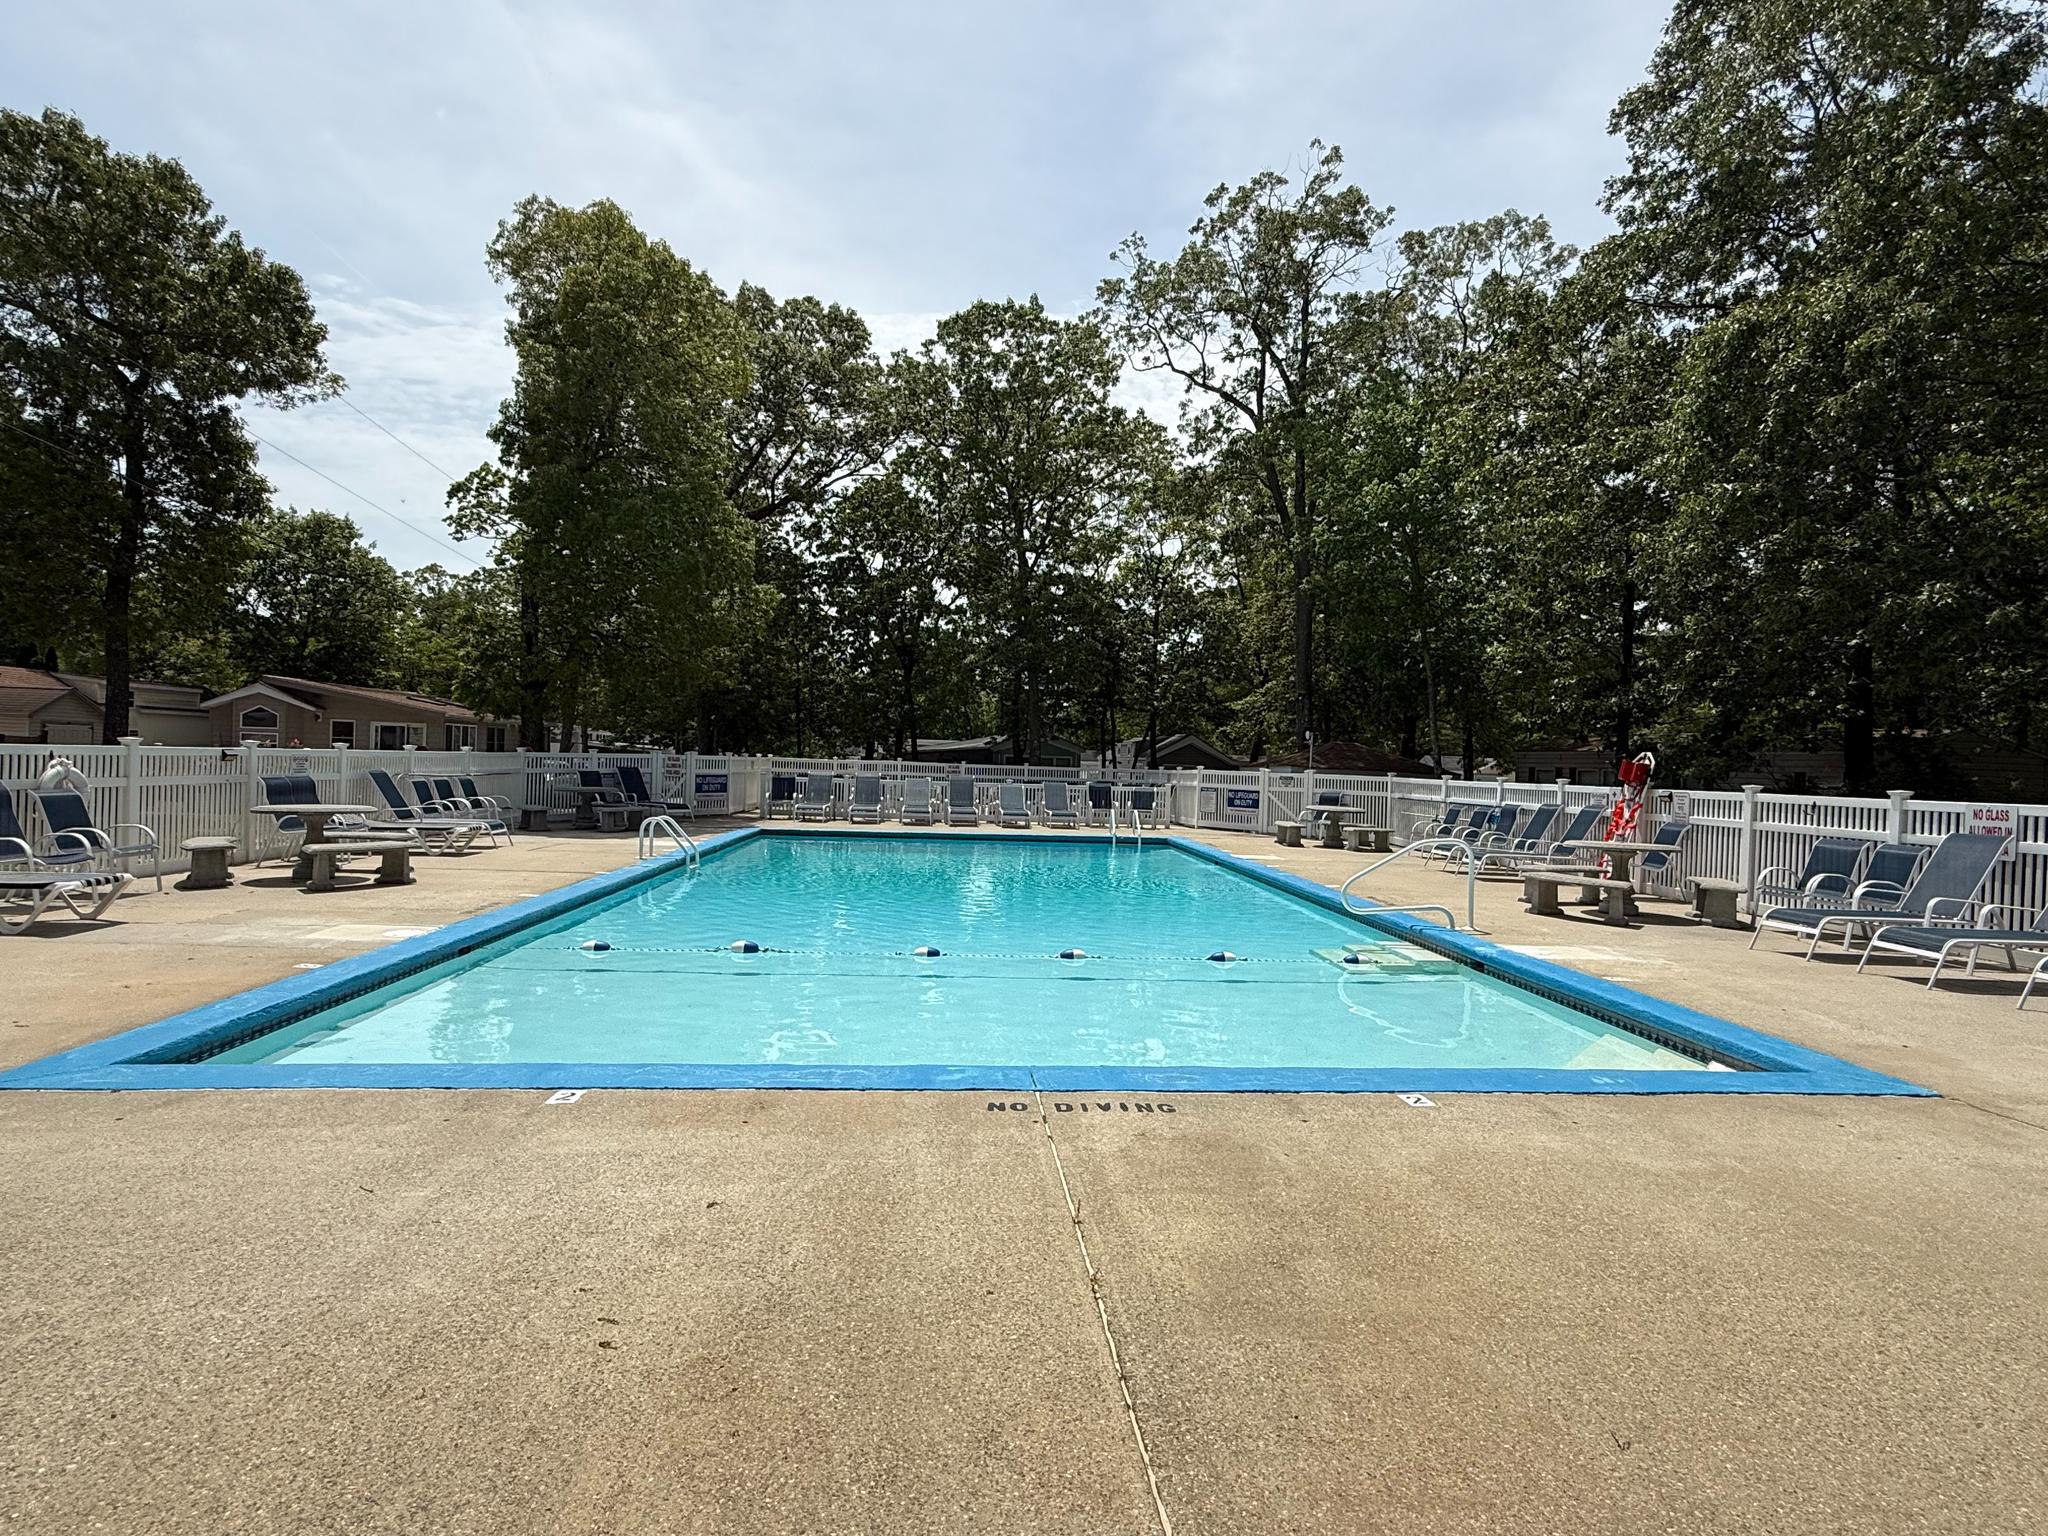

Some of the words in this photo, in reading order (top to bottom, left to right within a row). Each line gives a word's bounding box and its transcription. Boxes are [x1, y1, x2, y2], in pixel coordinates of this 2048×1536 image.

[1235, 791, 1259, 800] LIFEGUARD
[1973, 808, 1983, 820] NO
[1985, 809, 2010, 822] GLASS
[555, 1092, 577, 1101] 2
[1406, 1096, 1428, 1105] 2
[987, 1102, 1028, 1112] NO
[1054, 1102, 1177, 1113] DIVING
